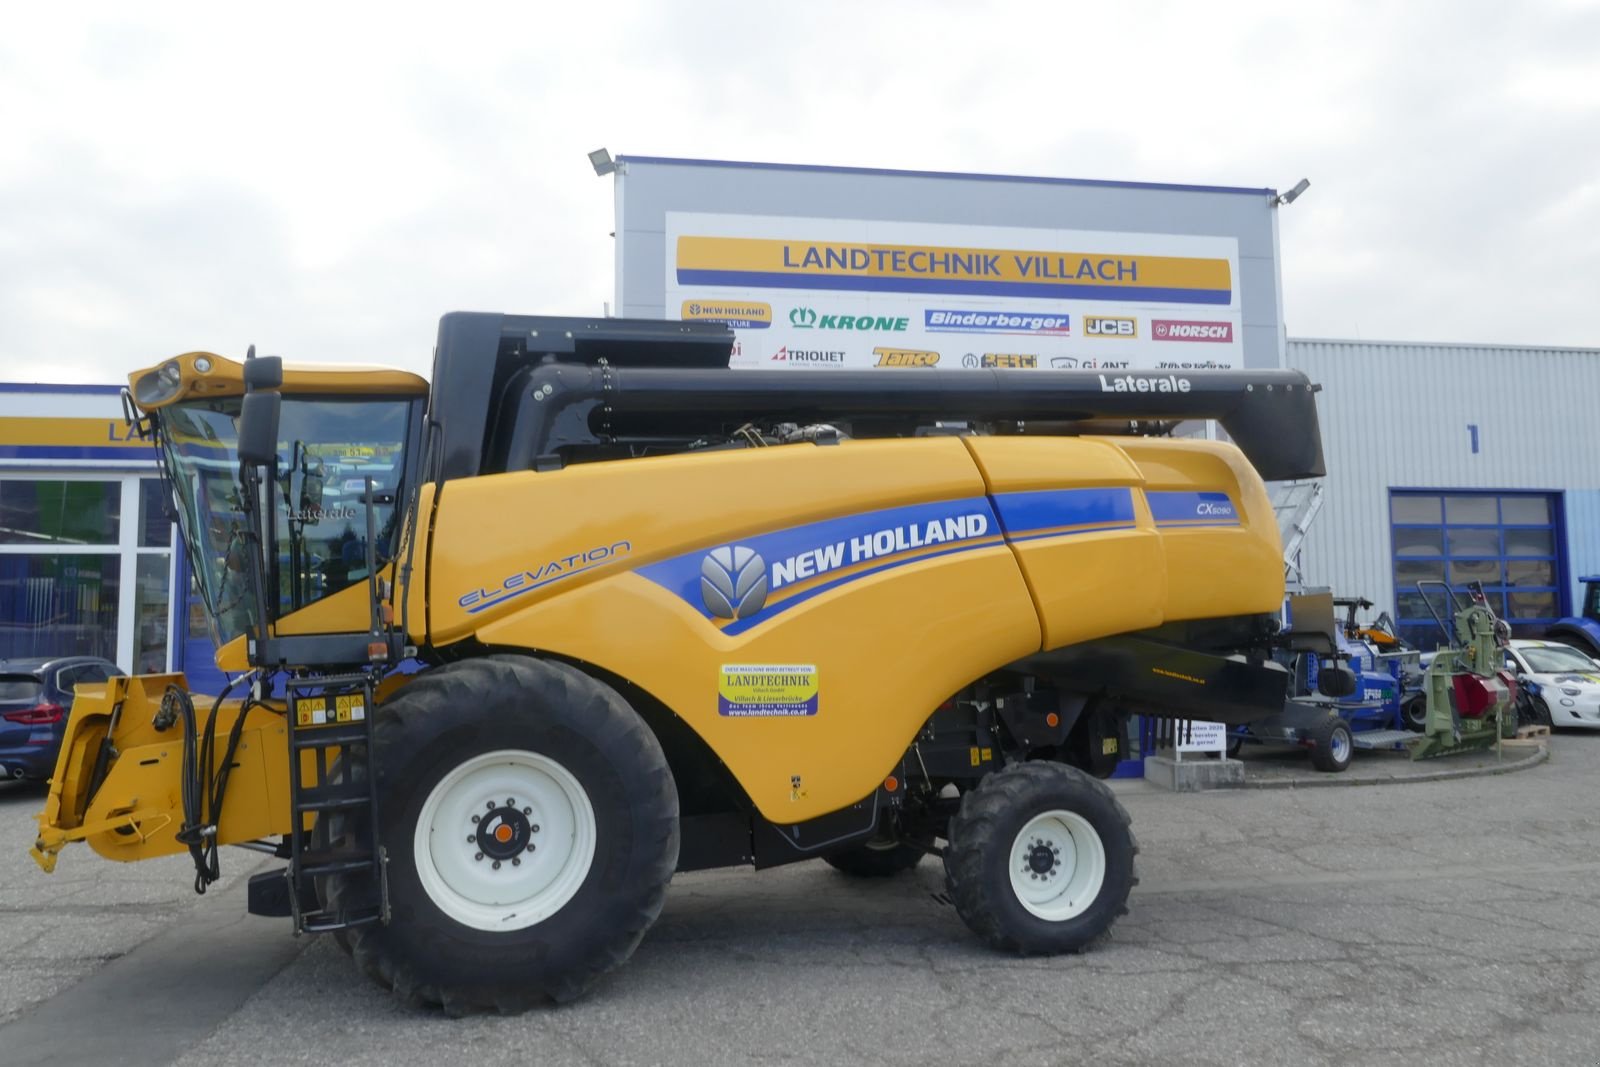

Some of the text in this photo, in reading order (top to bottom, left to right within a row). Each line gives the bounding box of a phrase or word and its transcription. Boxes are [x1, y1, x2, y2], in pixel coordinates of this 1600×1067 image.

[783, 245, 1138, 282] LANDTECHNIK VILLACH
[725, 307, 764, 316] HOLLAND
[819, 314, 909, 331] KRONE
[930, 311, 1066, 330] Binderberger
[1086, 319, 1134, 336] JCB
[1169, 324, 1228, 338] HORSCH
[787, 350, 846, 362] TRIOLIET
[1099, 374, 1191, 393] Laterale
[772, 513, 988, 588] NEW HOLLAND
[457, 540, 632, 608] ELEVATION
[727, 675, 810, 686] LANDTECHNIK
